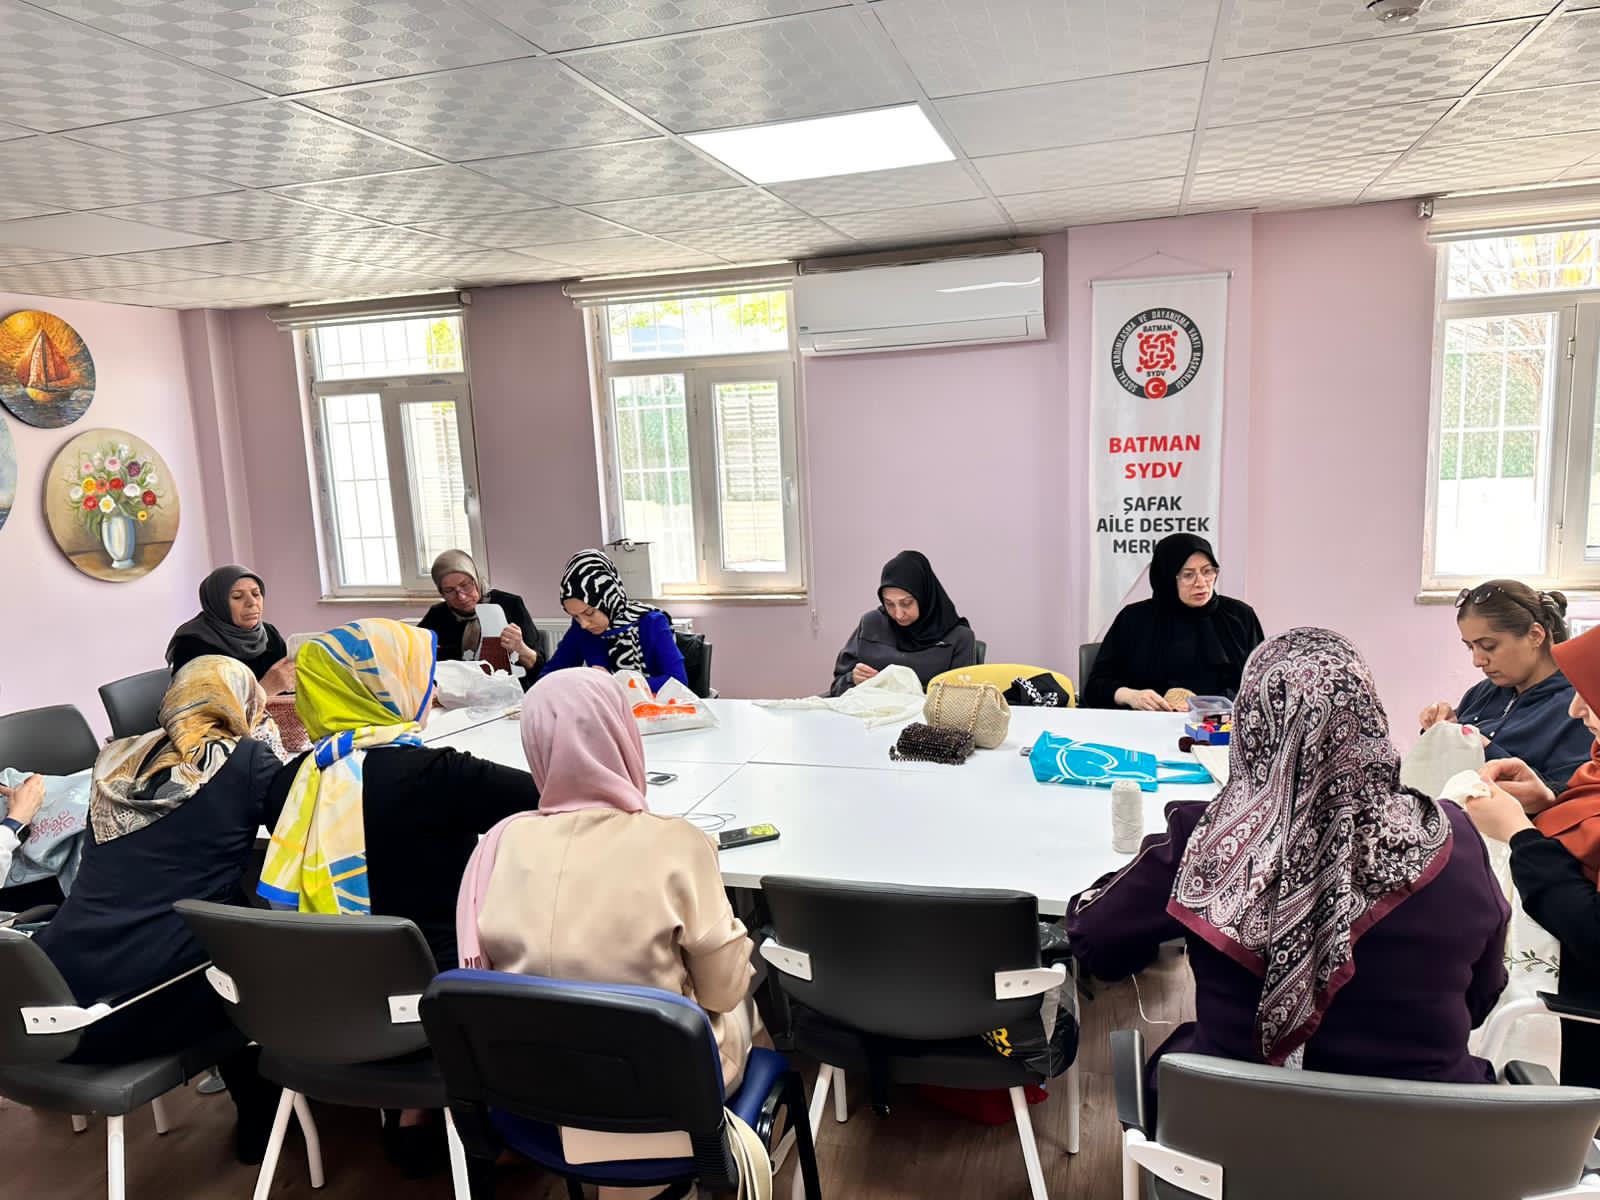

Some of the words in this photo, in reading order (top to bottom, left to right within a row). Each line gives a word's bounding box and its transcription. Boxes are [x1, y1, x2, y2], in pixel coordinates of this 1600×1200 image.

[1138, 314, 1148, 323] VE
[1151, 311, 1190, 328] DAYANIŞMA
[1143, 324, 1173, 332] BATMAN
[1113, 322, 1136, 368] YARDIMLAŞMA
[1118, 371, 1138, 392] SOSYAL
[1109, 434, 1201, 453] BATMAN
[1125, 462, 1183, 479] SYDV
[1123, 496, 1182, 515] ŞAFAK
[1096, 515, 1134, 532] AİLE
[1140, 517, 1210, 532] DESTEK
